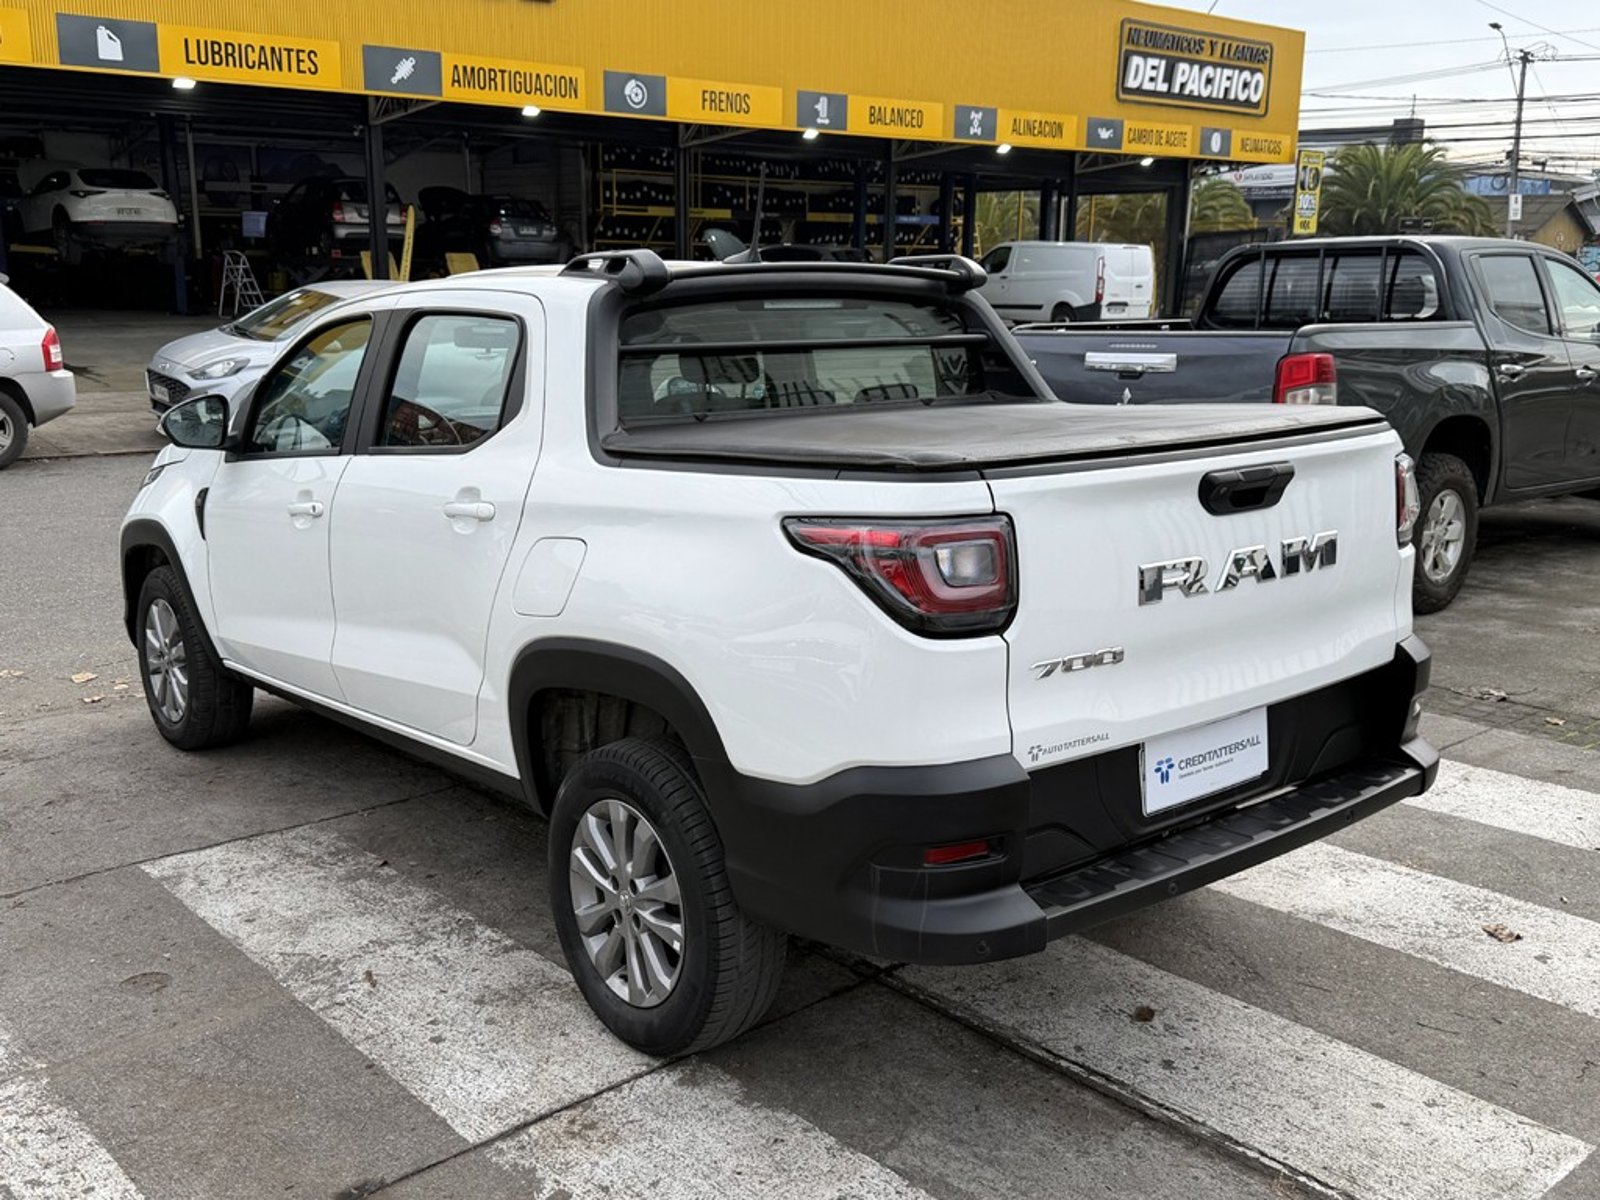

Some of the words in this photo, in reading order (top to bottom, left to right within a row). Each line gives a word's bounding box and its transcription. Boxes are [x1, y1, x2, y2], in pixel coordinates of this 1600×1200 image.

[184, 37, 319, 76] LUBRICANTES
[1127, 27, 1205, 54] NEUMATICOS
[1208, 39, 1218, 57] Y
[1219, 42, 1269, 64] LLANTAS
[451, 64, 579, 99] AMORTIGUACION
[1124, 54, 1169, 93] DEL
[1171, 61, 1265, 103] PACIFICO
[701, 89, 751, 114] FRENOS
[868, 105, 924, 128] BALANCEO
[1011, 117, 1065, 139] ALINEACION
[1127, 127, 1154, 145] CAMBIO
[1154, 129, 1164, 146] DE
[1165, 130, 1188, 147] ACEITE
[1240, 136, 1282, 155] NEUMATICOS
[1138, 529, 1338, 607] RAM
[1030, 646, 1124, 680] 700
[1178, 735, 1261, 771] CREDITATTERSALL
